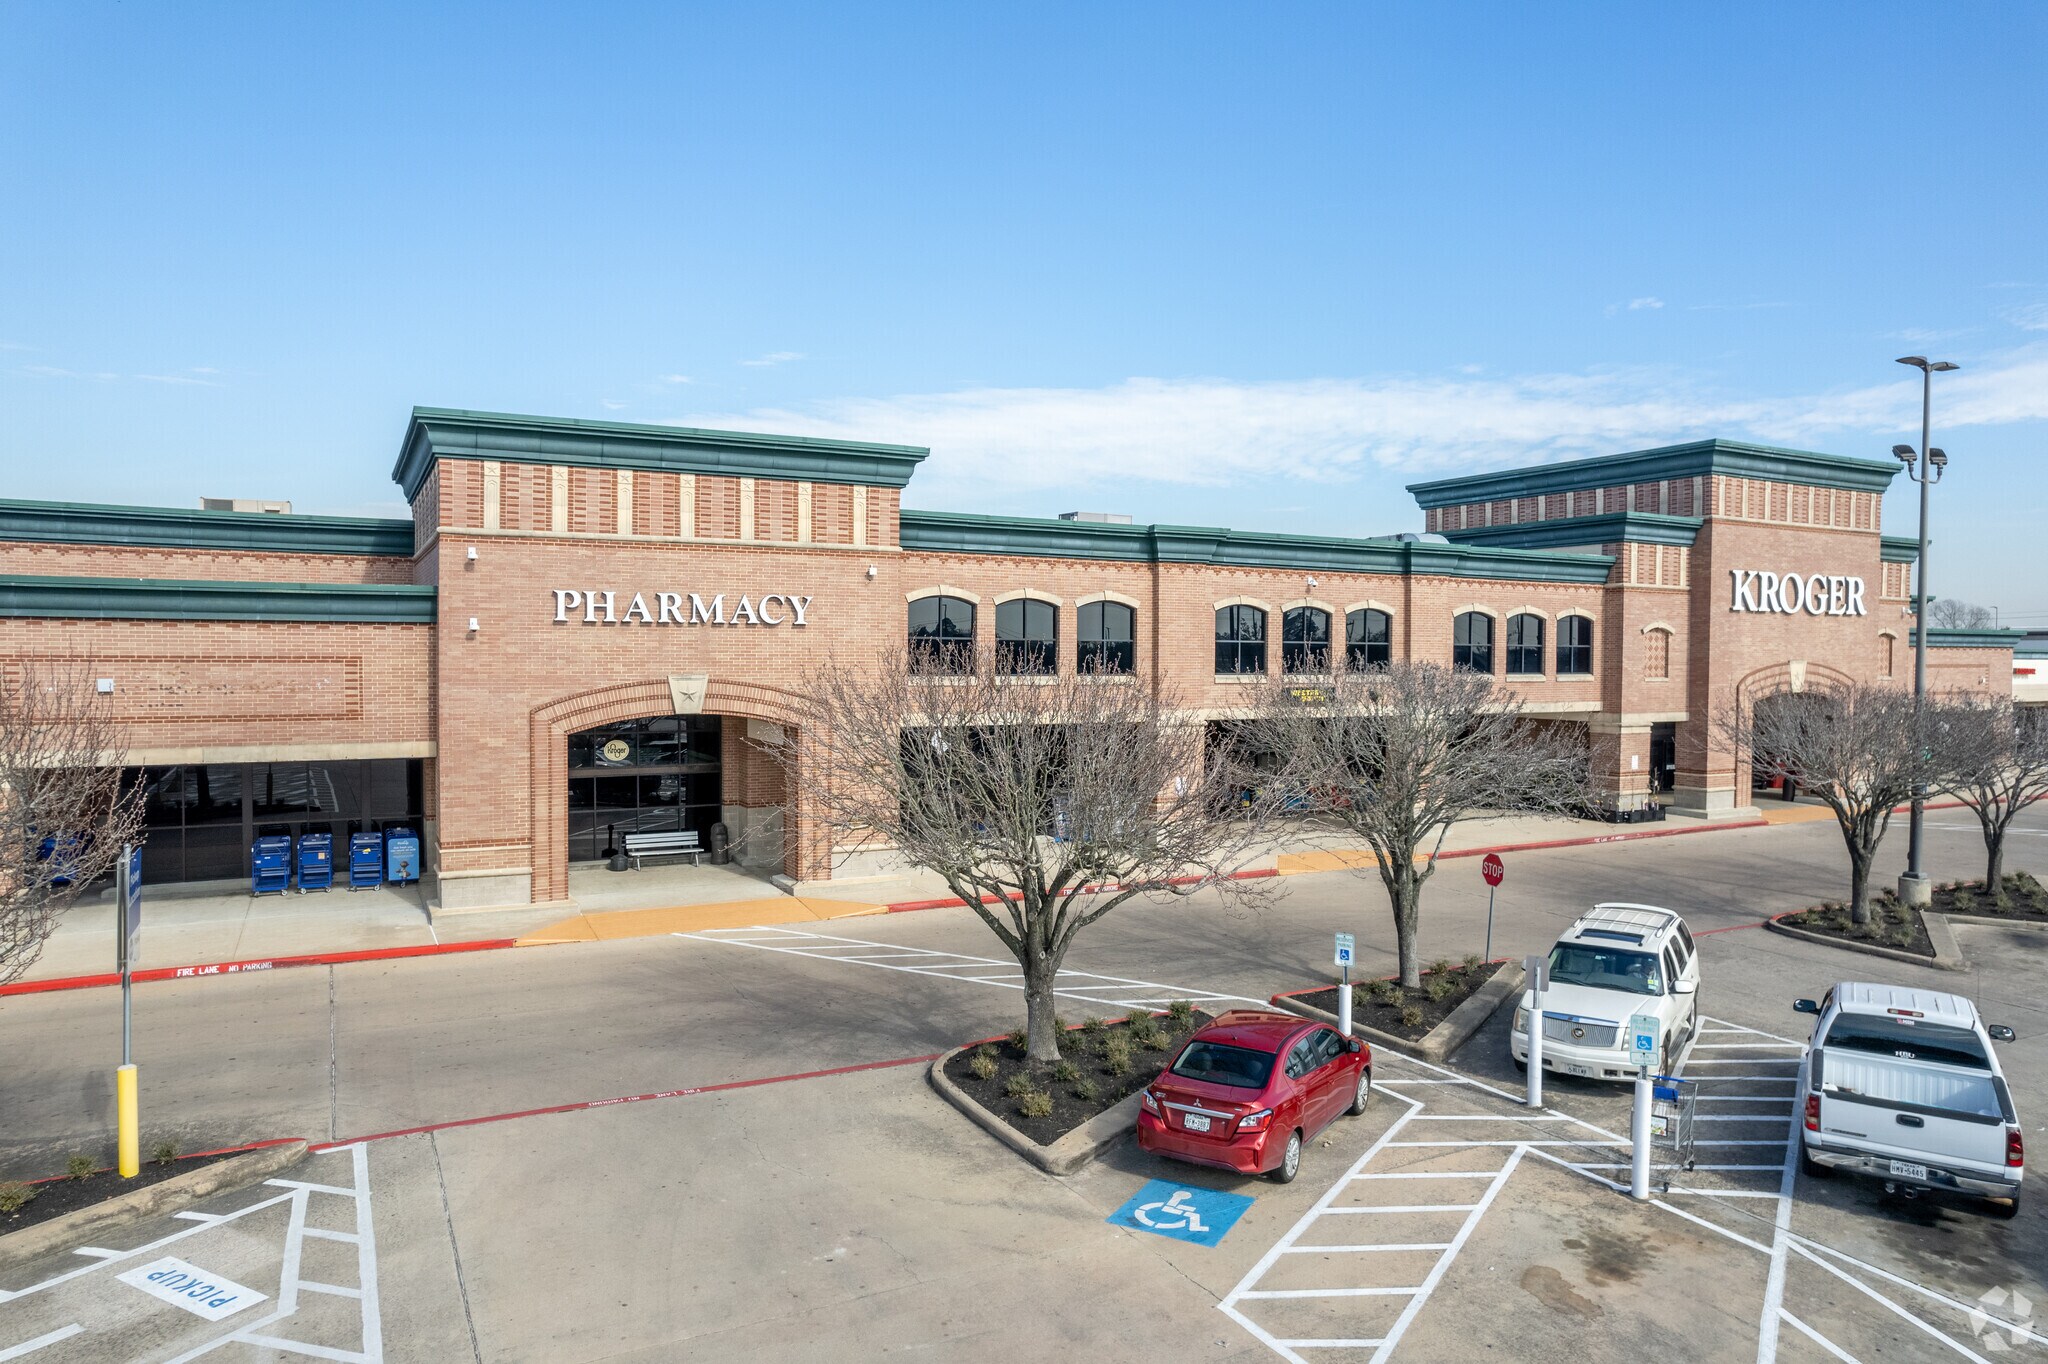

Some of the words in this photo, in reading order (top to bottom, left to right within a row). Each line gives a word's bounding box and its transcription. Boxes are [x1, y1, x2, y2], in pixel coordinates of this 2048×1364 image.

[553, 589, 813, 626] PHARMACY
[1730, 569, 1867, 615] KROGER
[1483, 861, 1503, 878] STOP
[176, 967, 195, 977] FIRE
[199, 965, 220, 975] LANE
[228, 964, 239, 972] NO
[243, 961, 273, 971] PARKING
[147, 1269, 238, 1309] PICKUP
